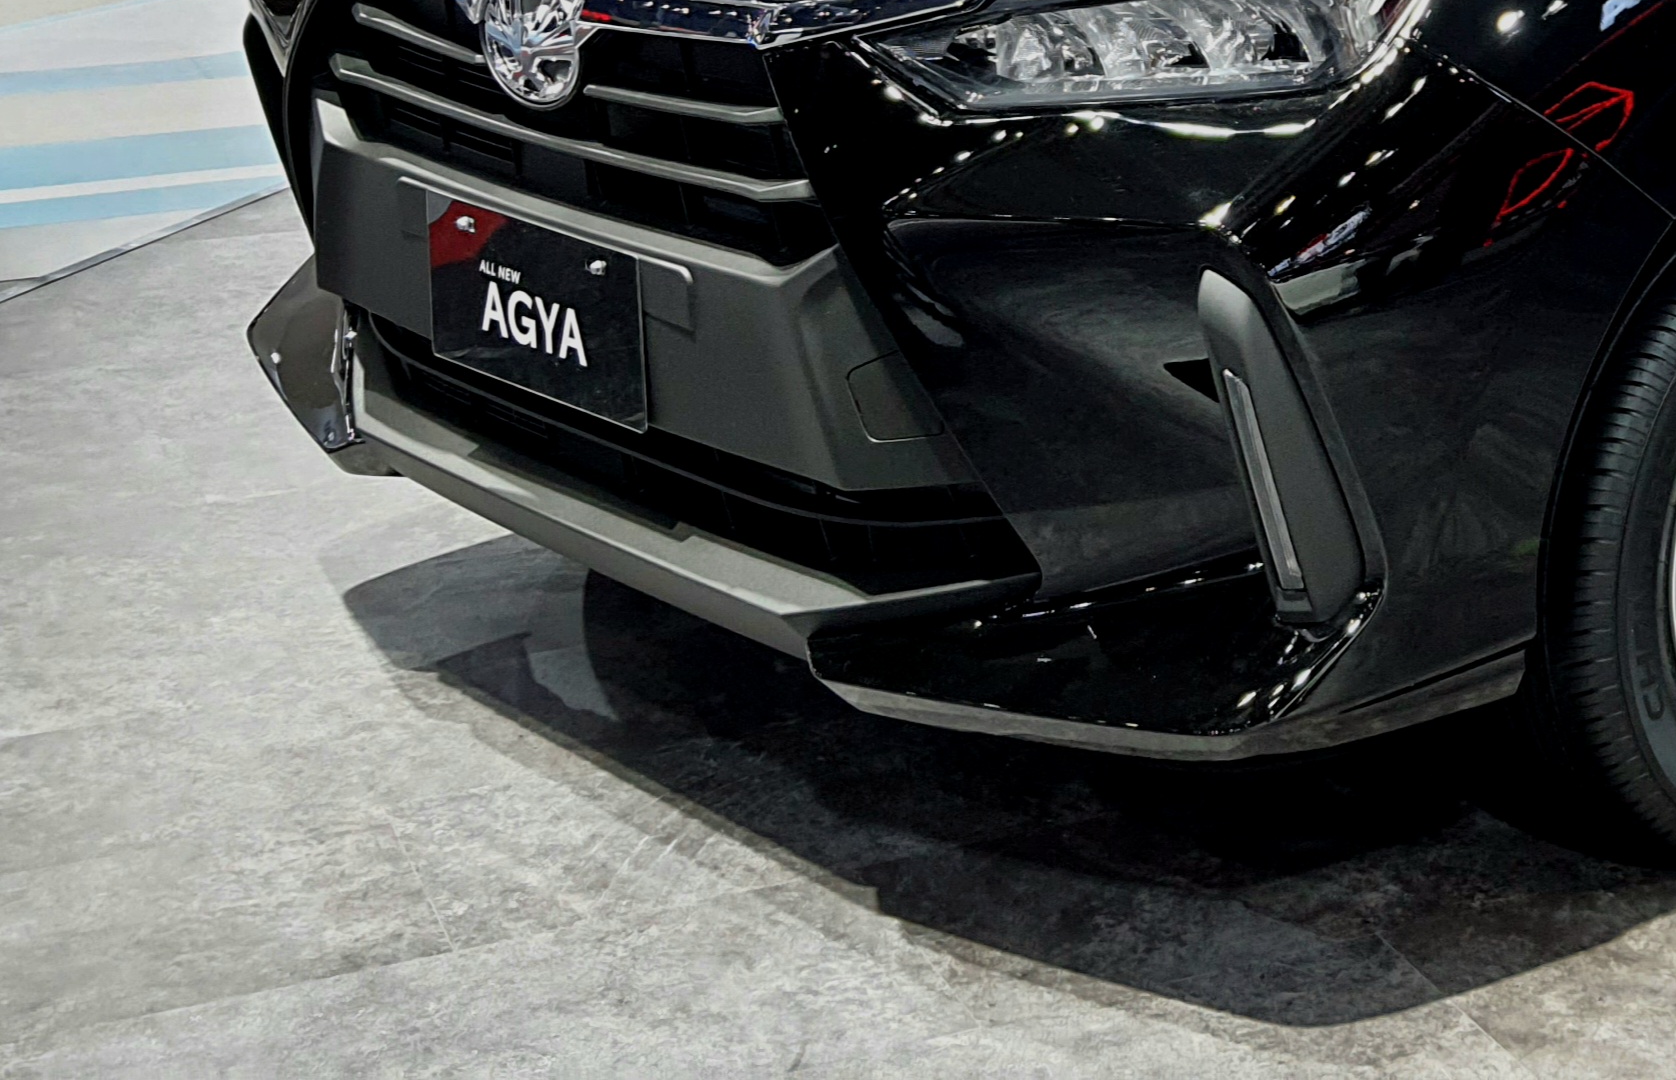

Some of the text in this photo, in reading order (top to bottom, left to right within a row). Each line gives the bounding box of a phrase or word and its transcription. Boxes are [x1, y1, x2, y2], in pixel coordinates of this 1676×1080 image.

[479, 259, 521, 284] ALL NEW
[481, 280, 588, 367] AGYA
